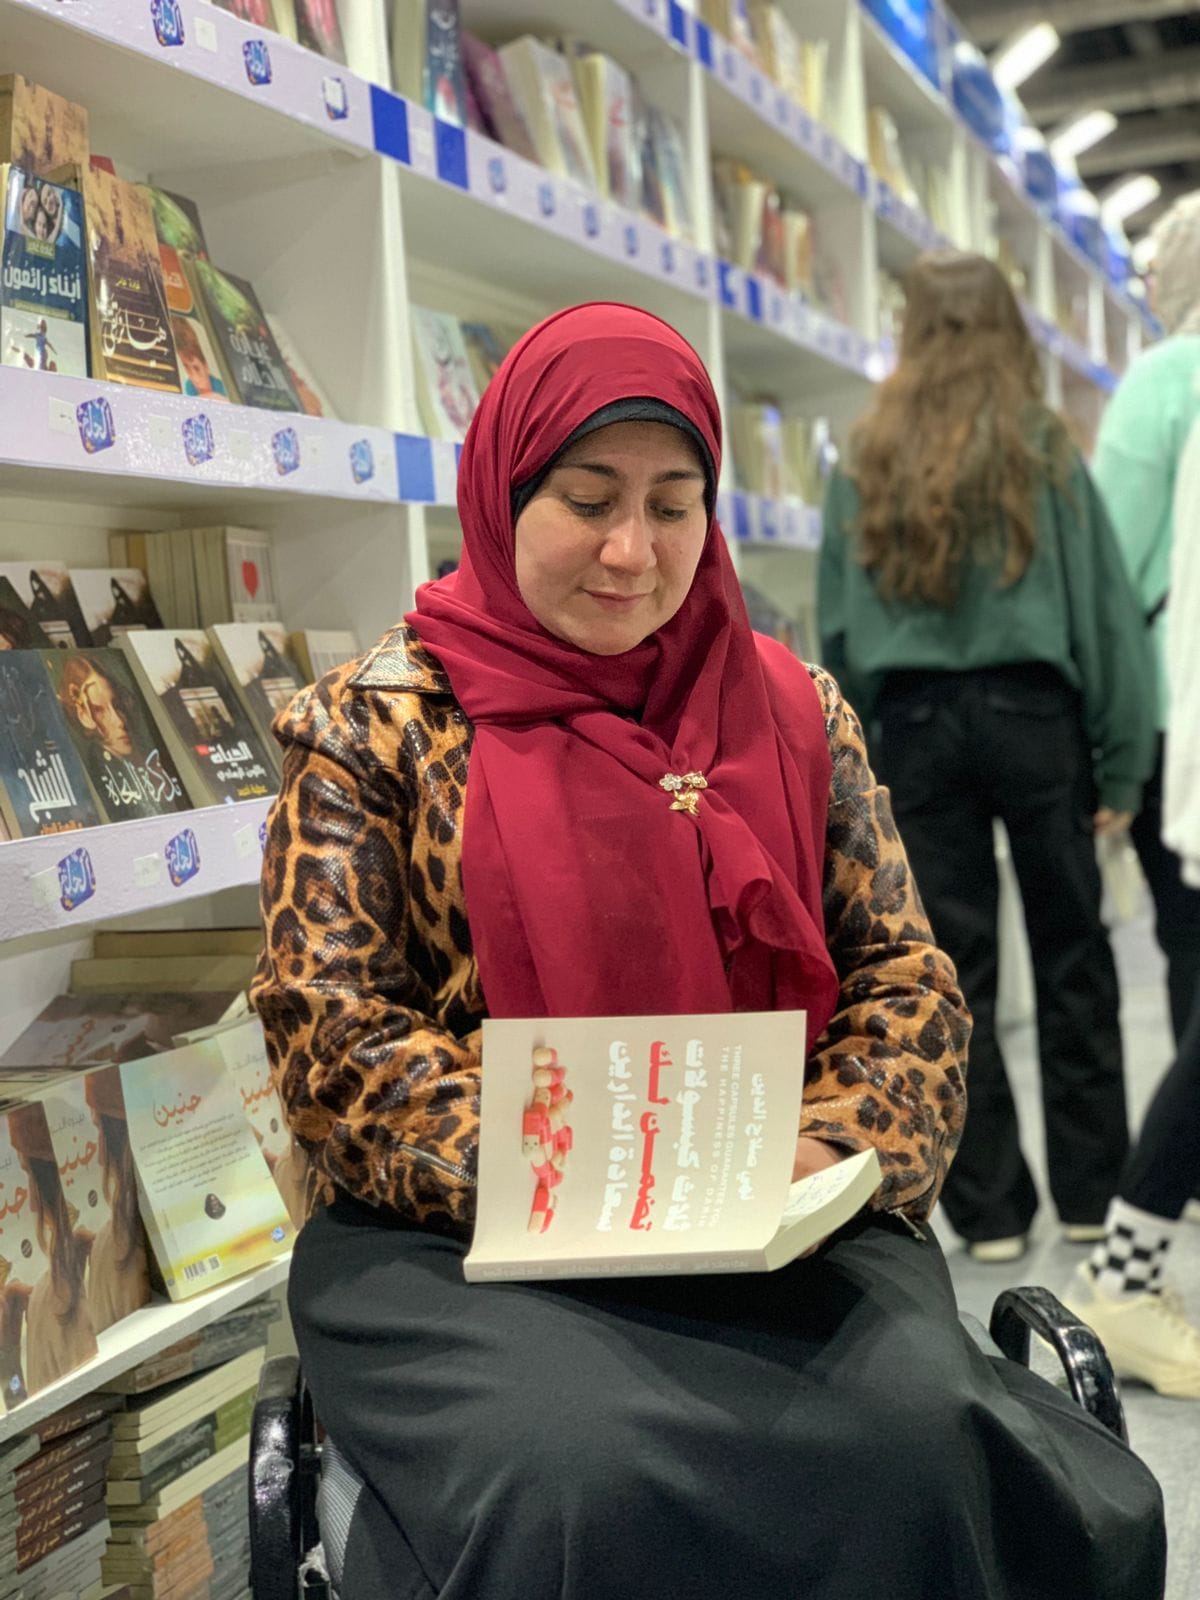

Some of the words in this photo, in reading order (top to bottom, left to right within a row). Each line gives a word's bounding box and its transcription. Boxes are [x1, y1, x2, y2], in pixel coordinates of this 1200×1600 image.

[607, 1040, 637, 1140] الدارين
[720, 1046, 730, 1072] THE
[731, 1045, 743, 1080] THREE
[153, 1092, 202, 1127] حنين
[630, 1111, 661, 1231] تضمن
[648, 1040, 673, 1105] لك
[672, 1039, 709, 1169] كبسولات
[712, 1078, 728, 1158] HAPPINESS
[726, 1082, 740, 1138] CAPSULES
[595, 1146, 635, 1231] سعادة
[662, 1174, 695, 1232] ثلاث
